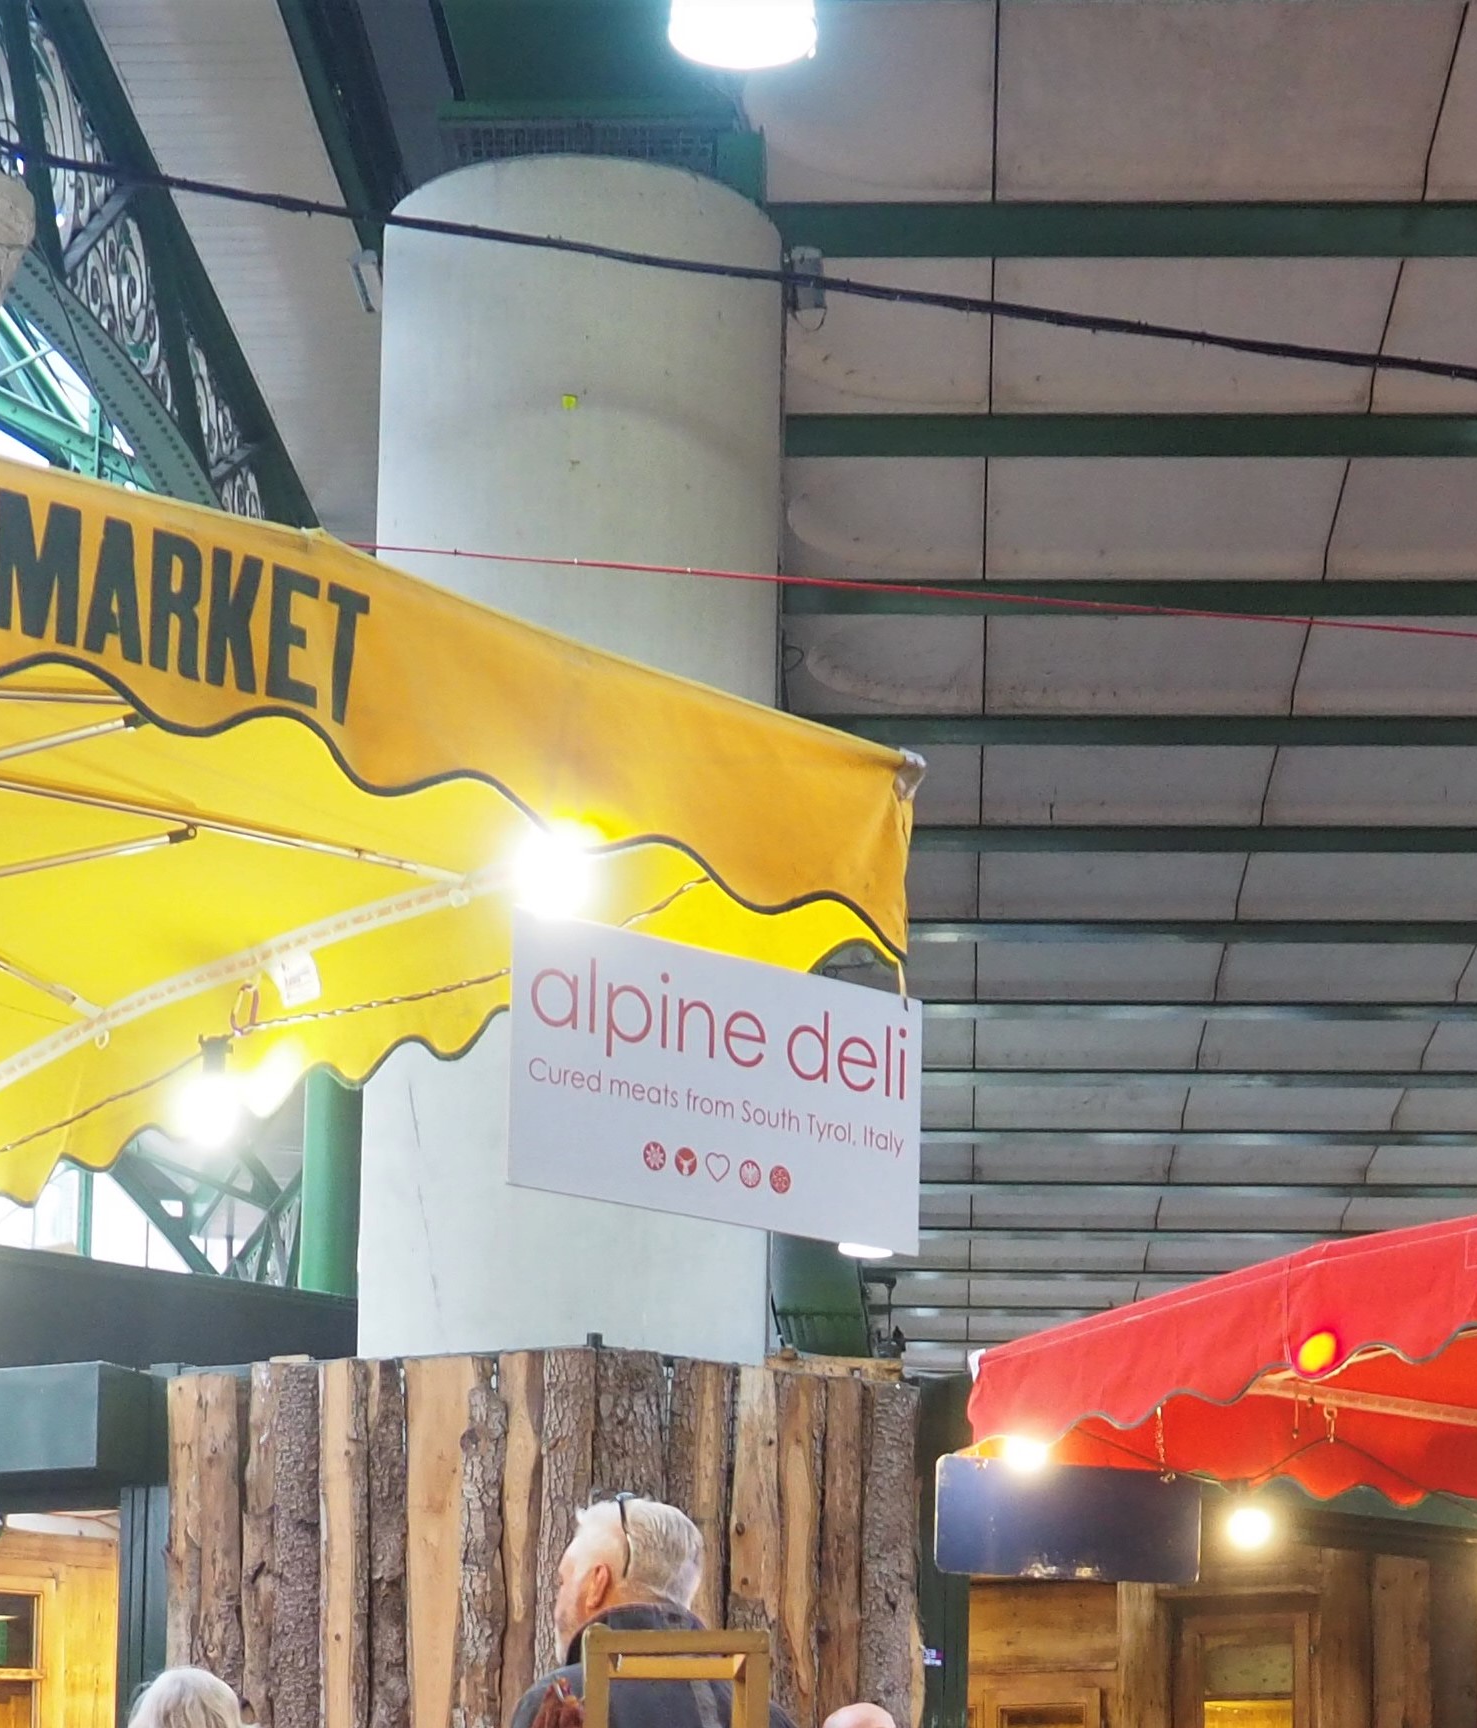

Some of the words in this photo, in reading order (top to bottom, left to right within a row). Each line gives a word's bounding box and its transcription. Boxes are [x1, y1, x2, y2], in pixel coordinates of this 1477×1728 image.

[531, 958, 766, 1068] alpine
[787, 1011, 908, 1101] deli
[529, 1057, 602, 1094] Cured
[609, 1077, 679, 1110] meats
[687, 1088, 735, 1121] from
[742, 1099, 800, 1135] South
[807, 1114, 857, 1148] Tyrol,
[864, 1123, 904, 1158] Italy
